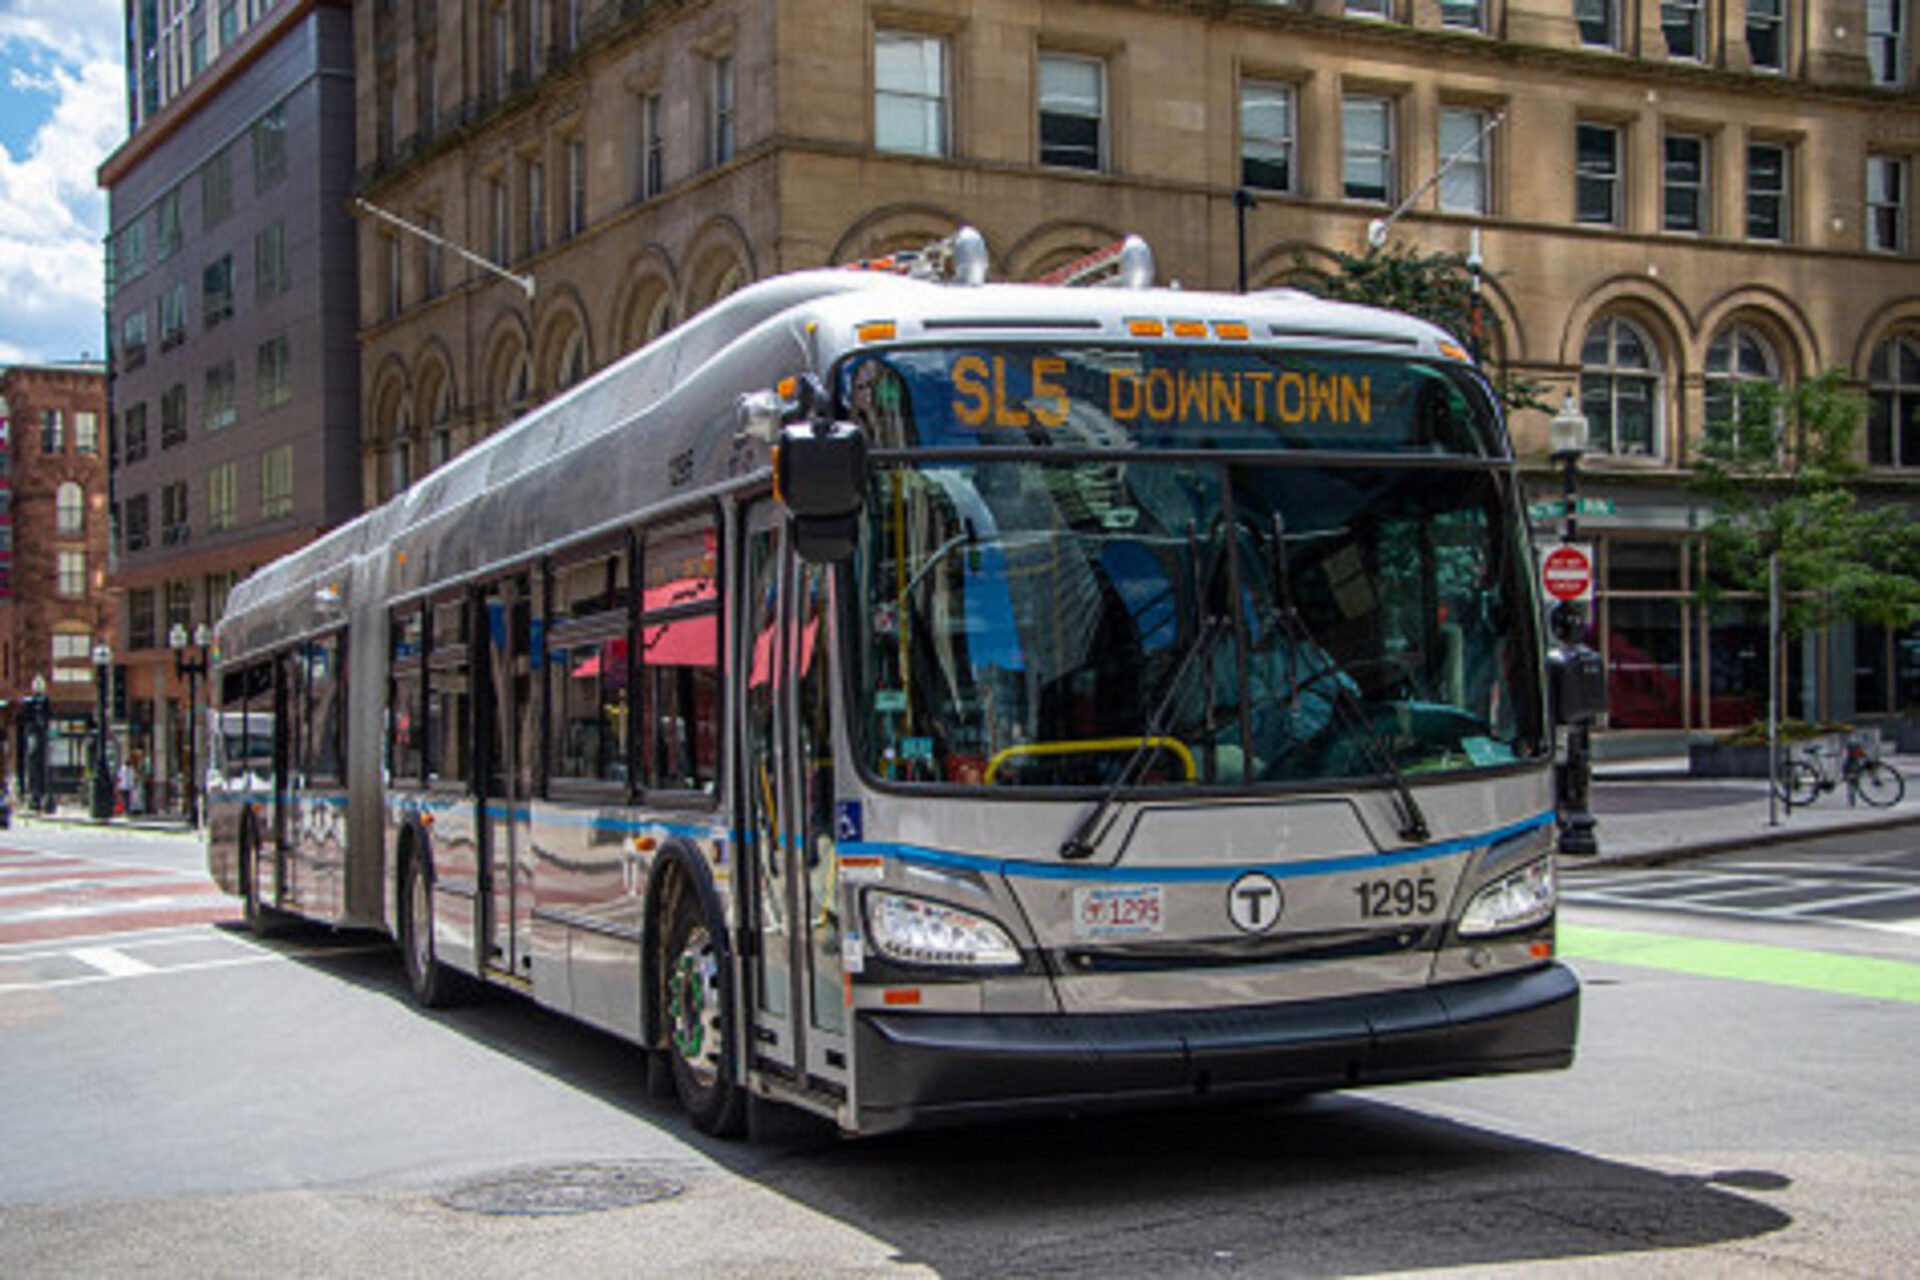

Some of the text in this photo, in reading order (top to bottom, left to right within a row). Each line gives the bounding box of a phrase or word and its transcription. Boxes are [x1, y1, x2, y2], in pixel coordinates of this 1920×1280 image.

[951, 356, 1371, 426] SL5 DOWNTOWN
[1237, 887, 1272, 924] T
[1353, 878, 1438, 919] 1295
